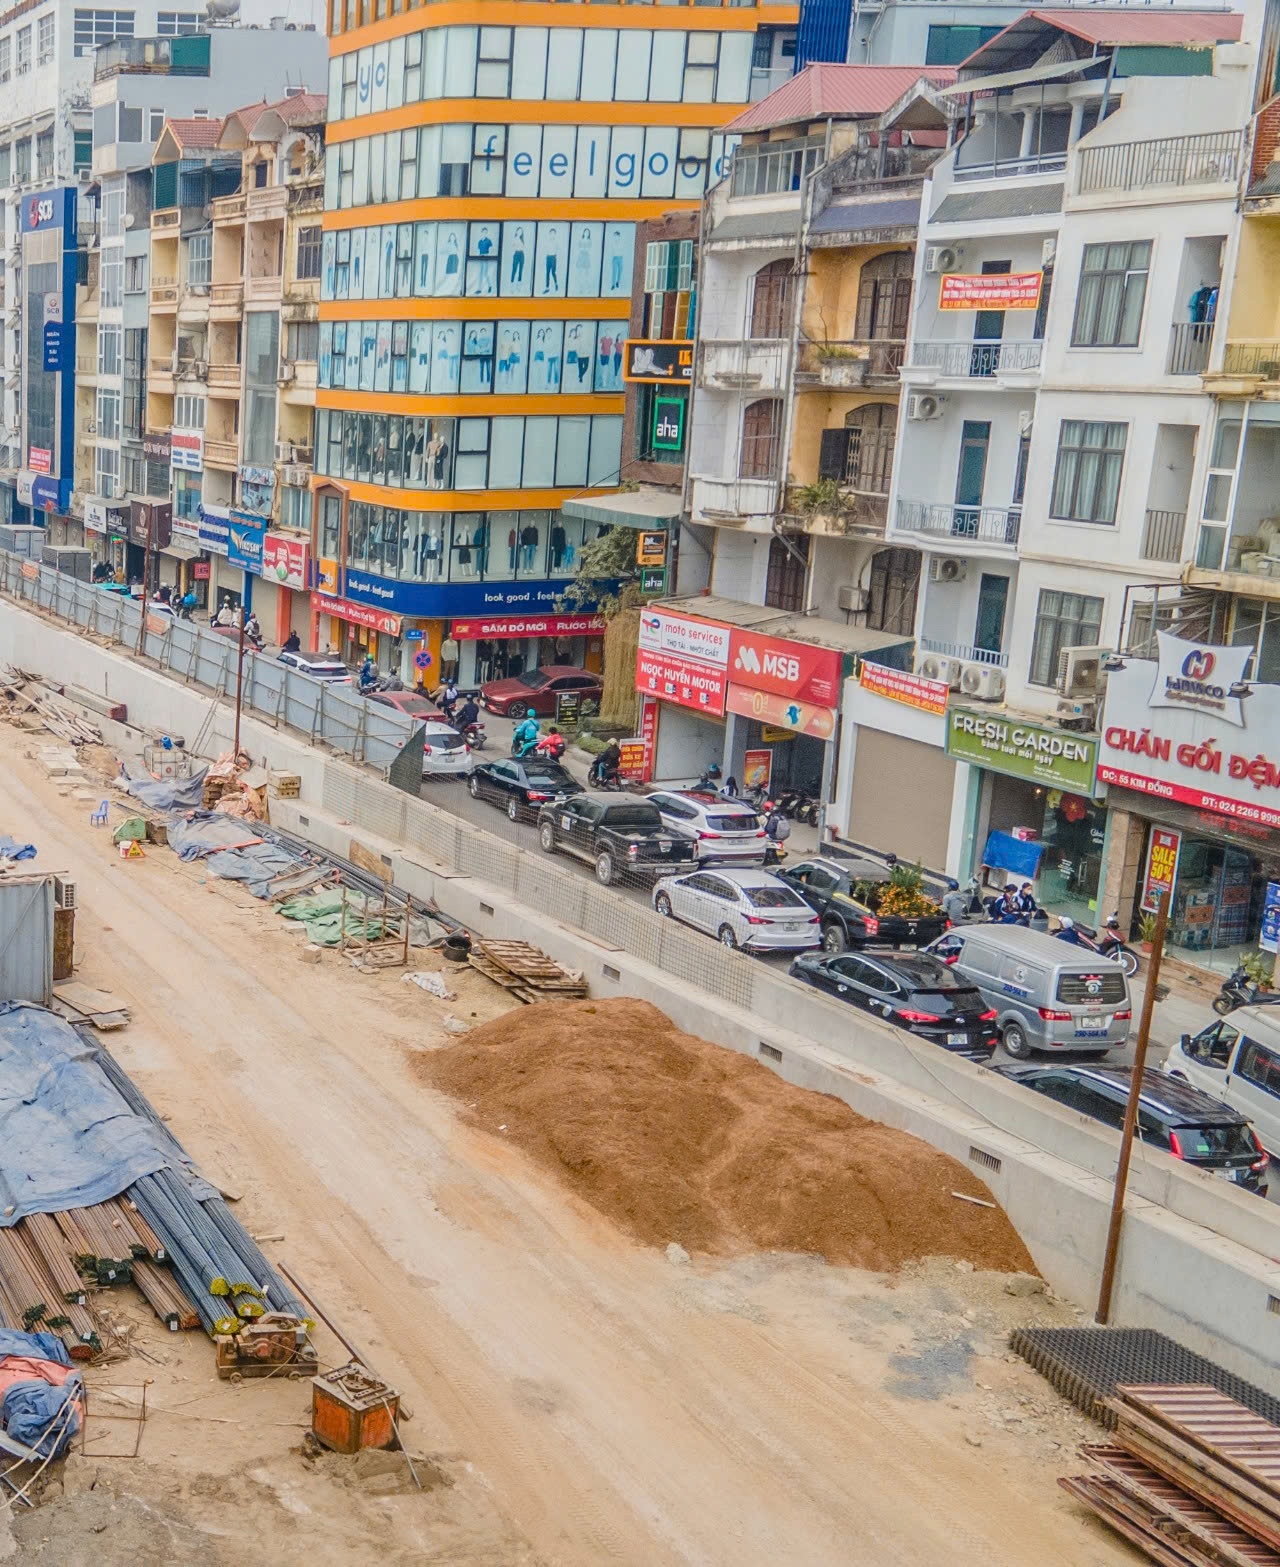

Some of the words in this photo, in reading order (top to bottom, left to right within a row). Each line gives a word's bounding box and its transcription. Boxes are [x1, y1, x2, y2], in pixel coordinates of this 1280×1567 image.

[38, 199, 53, 221] SCB
[46, 307, 60, 315] SCB
[656, 416, 679, 438] aha
[644, 575, 663, 588] aha
[484, 592, 504, 603] look
[506, 592, 530, 604] good
[664, 623, 686, 637] moto
[688, 629, 724, 646] services
[641, 662, 663, 678] NGỌC
[691, 675, 721, 694] MOTOR
[762, 654, 801, 682] MSB
[953, 714, 1009, 743] FRESH
[1011, 729, 1089, 764] GARDEN
[1105, 726, 1172, 762] CHĂN
[1176, 737, 1223, 774] GỐI
[1119, 774, 1129, 784] 55
[1129, 777, 1147, 789] KIM
[1147, 780, 1174, 796] ĐỒNG
[1201, 796, 1218, 810] ĐT:
[1218, 801, 1236, 813] 024
[1151, 846, 1176, 867] SALE
[1150, 863, 1172, 883] 50%
